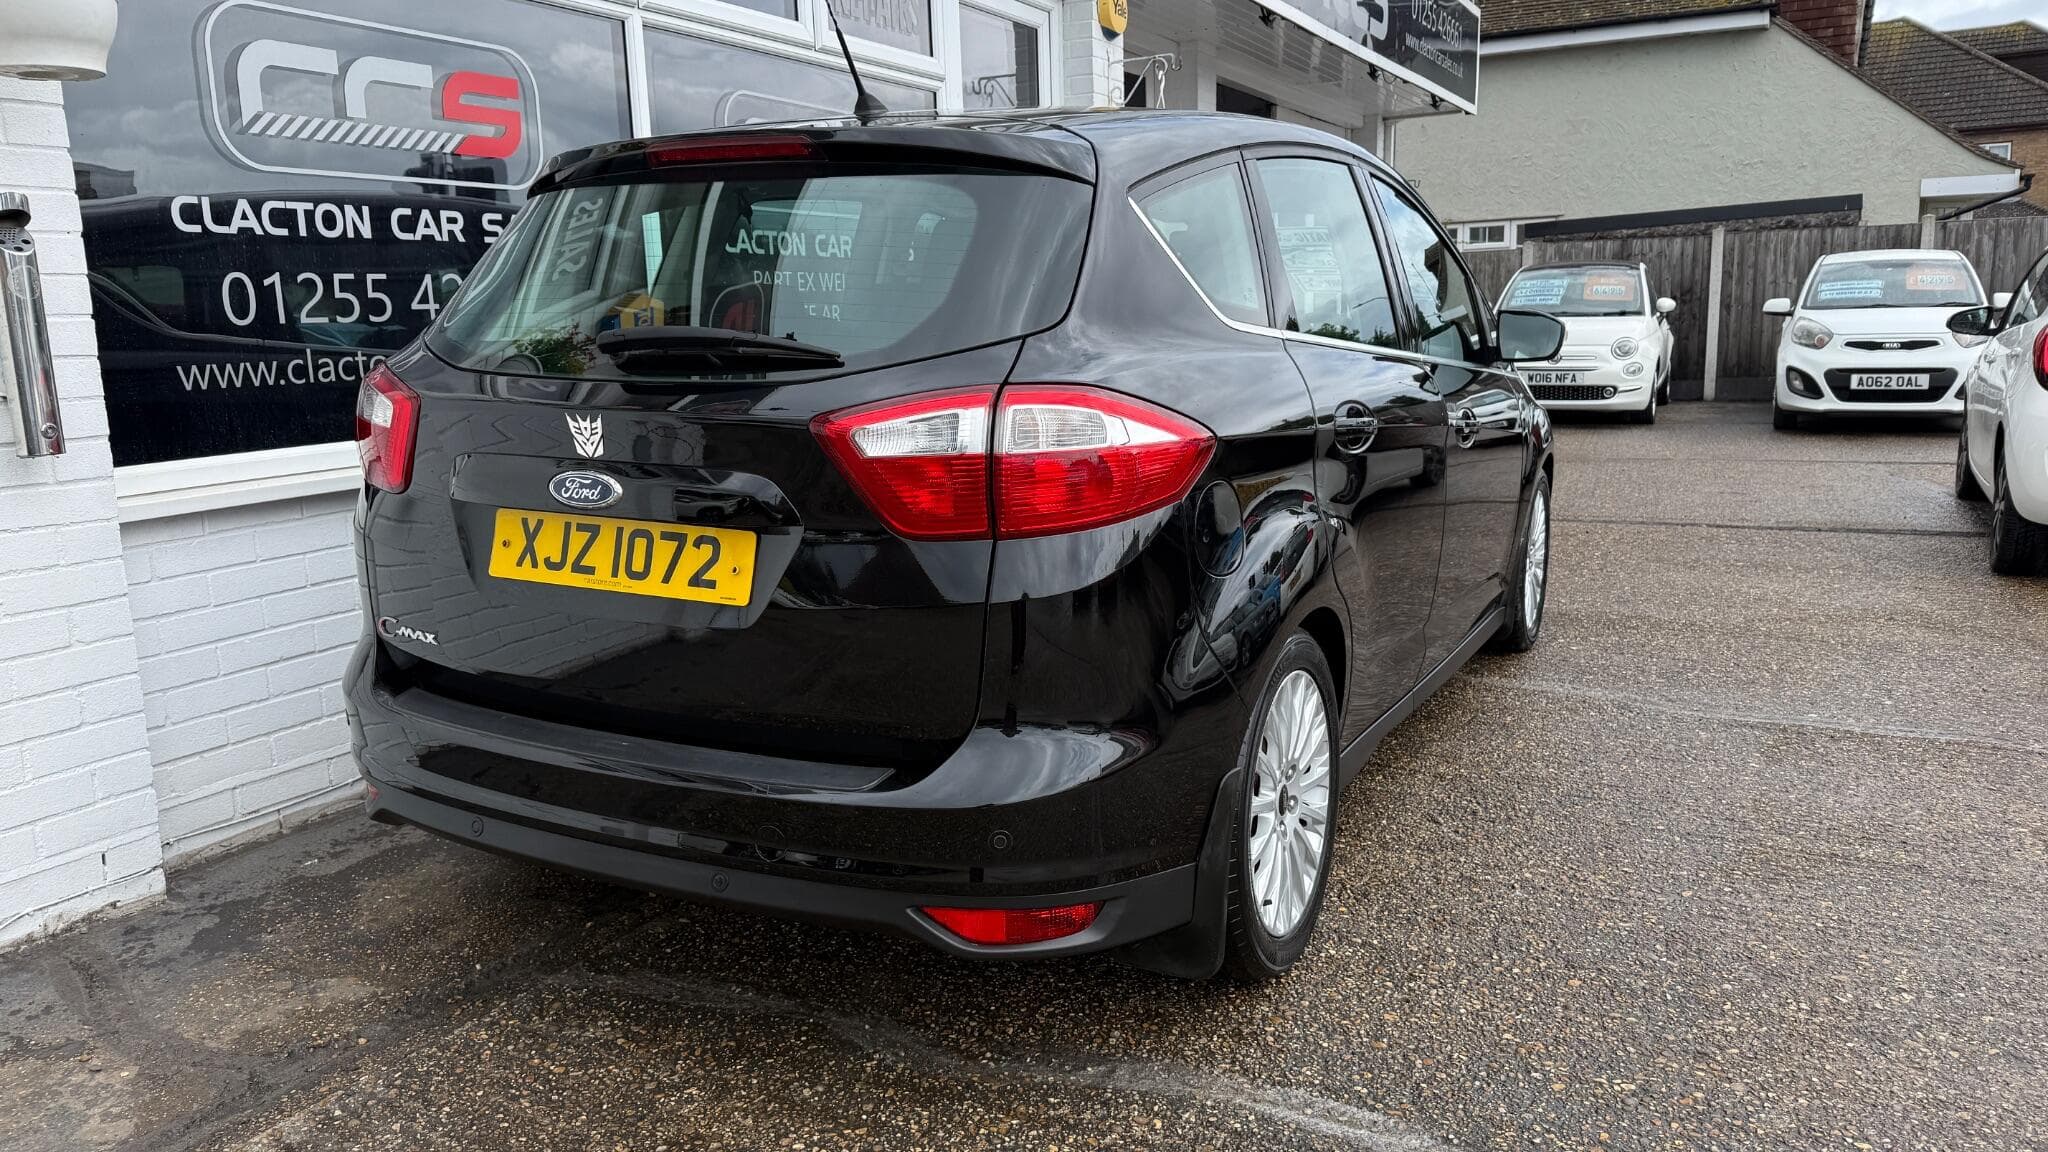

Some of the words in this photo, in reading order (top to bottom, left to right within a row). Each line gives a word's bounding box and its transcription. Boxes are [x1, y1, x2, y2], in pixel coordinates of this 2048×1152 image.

[170, 195, 372, 240] CLACTON
[390, 207, 466, 243] CAR
[481, 211, 518, 245] S
[797, 271, 817, 292] EX
[221, 271, 393, 327] 01255
[1527, 373, 1552, 384] WO16
[1555, 373, 1577, 384] NFA
[1856, 376, 1893, 388] AO62
[1896, 376, 1923, 388] OAL
[561, 477, 602, 501] Ford
[516, 517, 602, 576] XJZ
[610, 526, 722, 591] 1072
[377, 616, 439, 646] C-MAX
